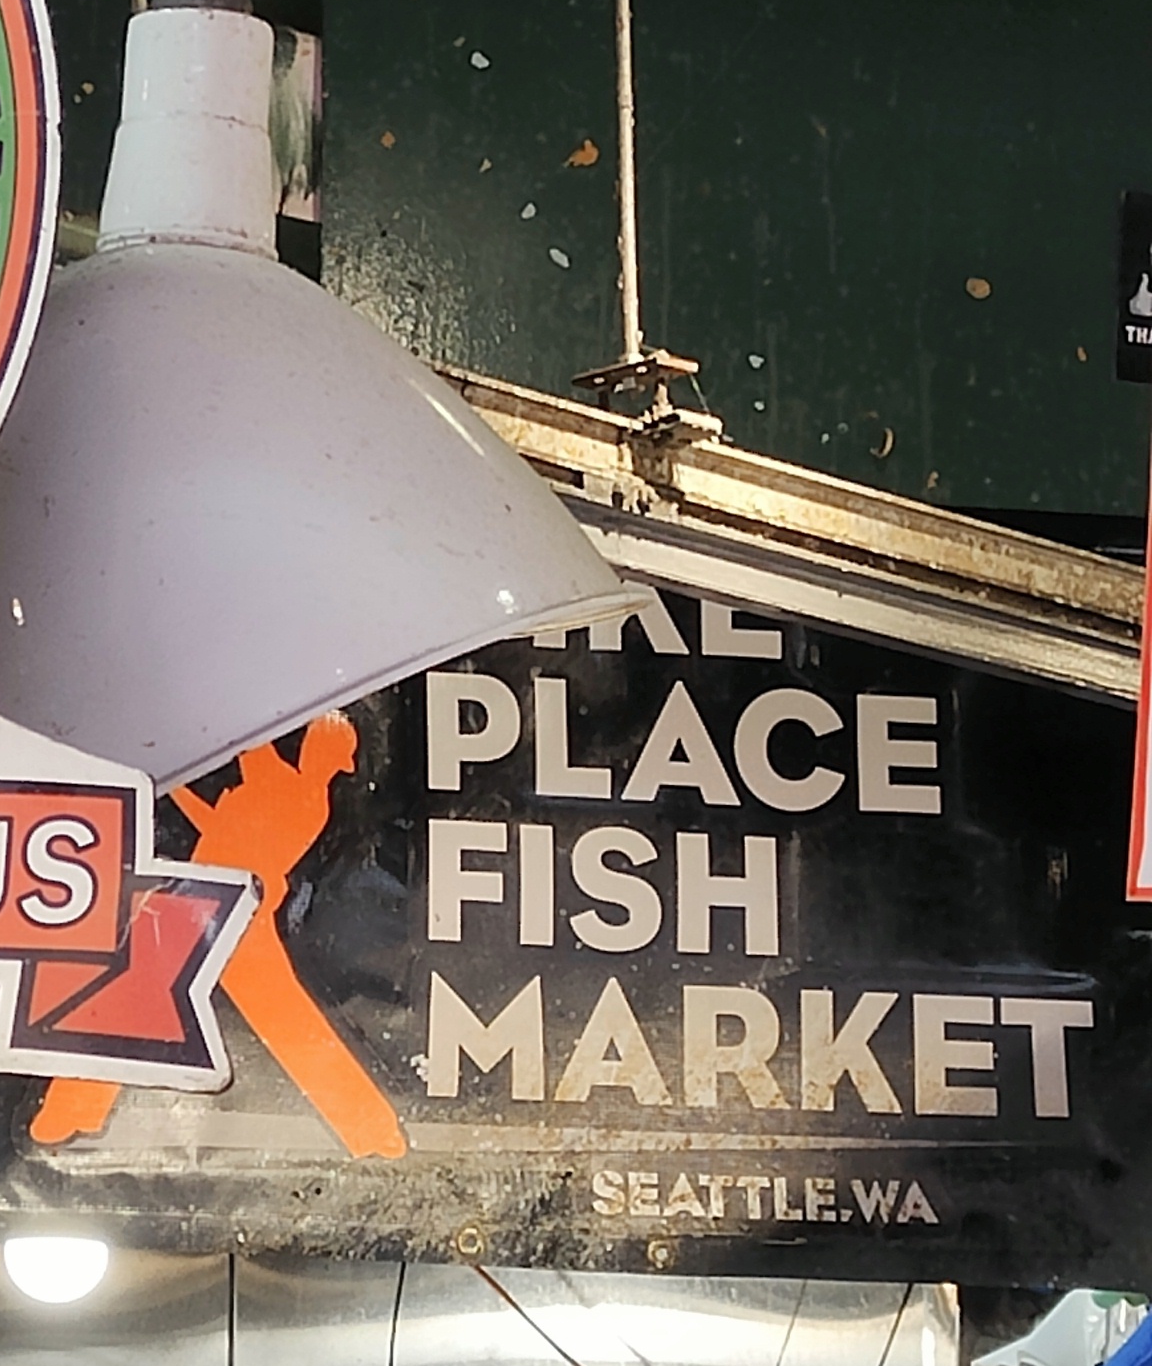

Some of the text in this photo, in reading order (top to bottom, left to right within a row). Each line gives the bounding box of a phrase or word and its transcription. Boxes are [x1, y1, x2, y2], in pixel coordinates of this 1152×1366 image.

[426, 670, 942, 814] PLACE
[427, 818, 780, 956] FISH
[425, 970, 1094, 1120] MARKET
